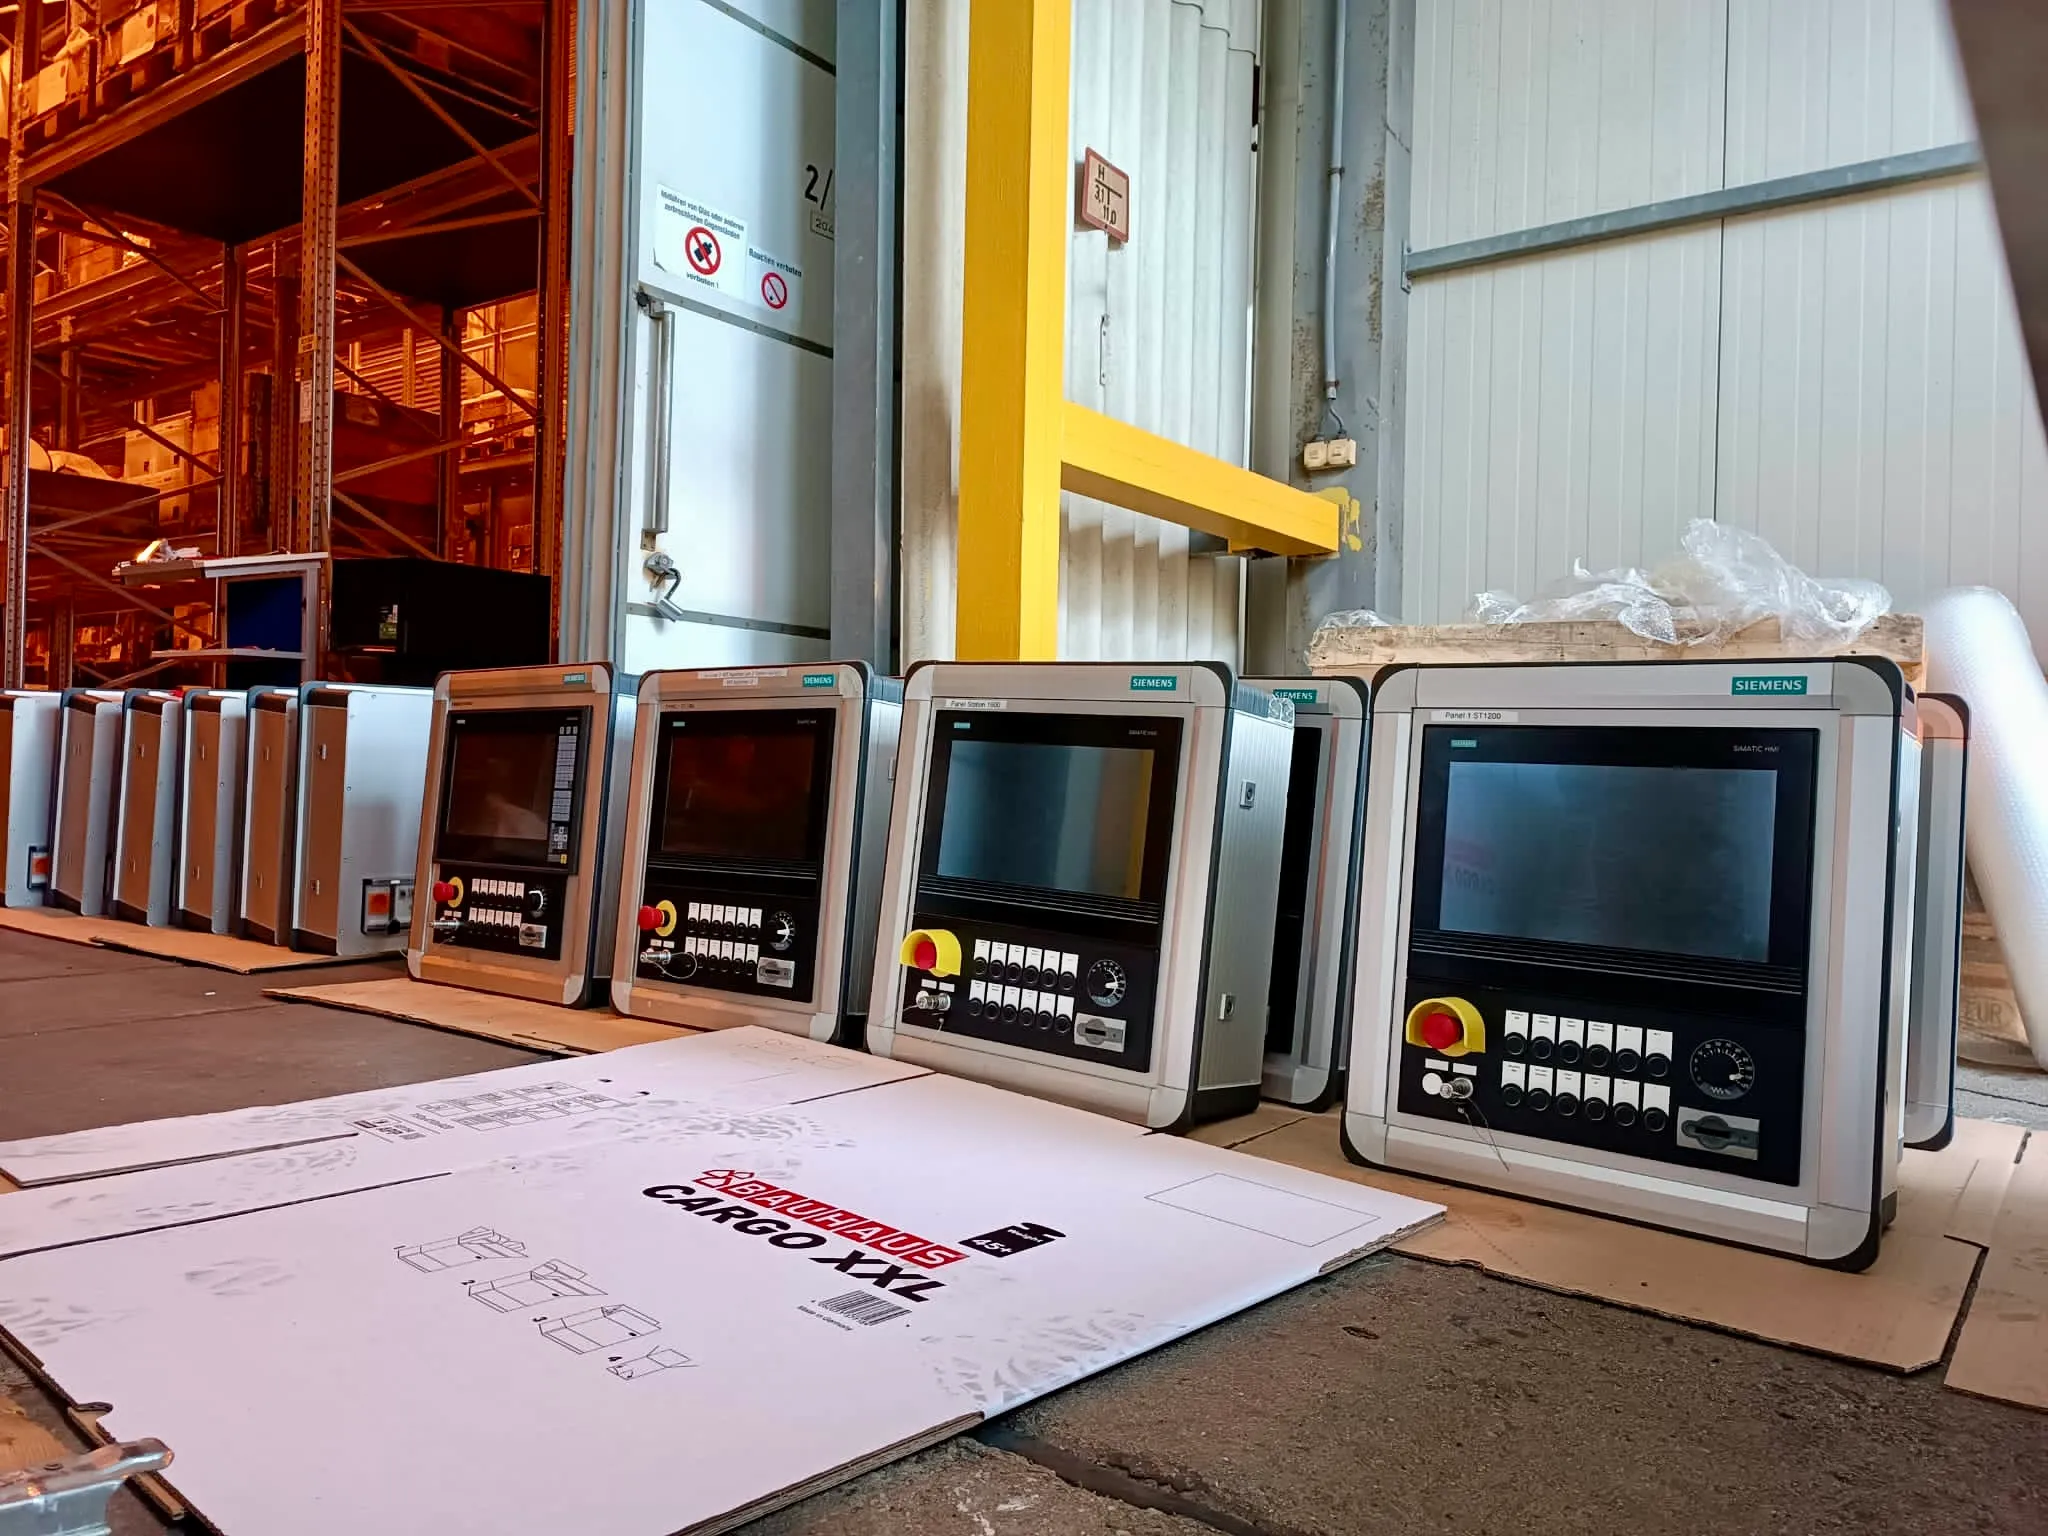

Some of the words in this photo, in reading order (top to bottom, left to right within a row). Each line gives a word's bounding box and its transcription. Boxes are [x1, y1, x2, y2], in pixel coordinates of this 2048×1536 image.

[1097, 164, 1105, 181] H
[1132, 678, 1173, 687] SIEMENS
[1735, 680, 1802, 691] SIEMENS
[1274, 691, 1313, 700] SIEMENS
[1445, 711, 1466, 719] Panel
[1473, 712, 1502, 720] ST1200
[1733, 745, 1763, 753] SIMATIC
[724, 1180, 962, 1268] BAUHAUS
[642, 1184, 827, 1249] CARGO
[808, 1250, 947, 1302] XXL
[972, 1240, 1012, 1253] 45+
